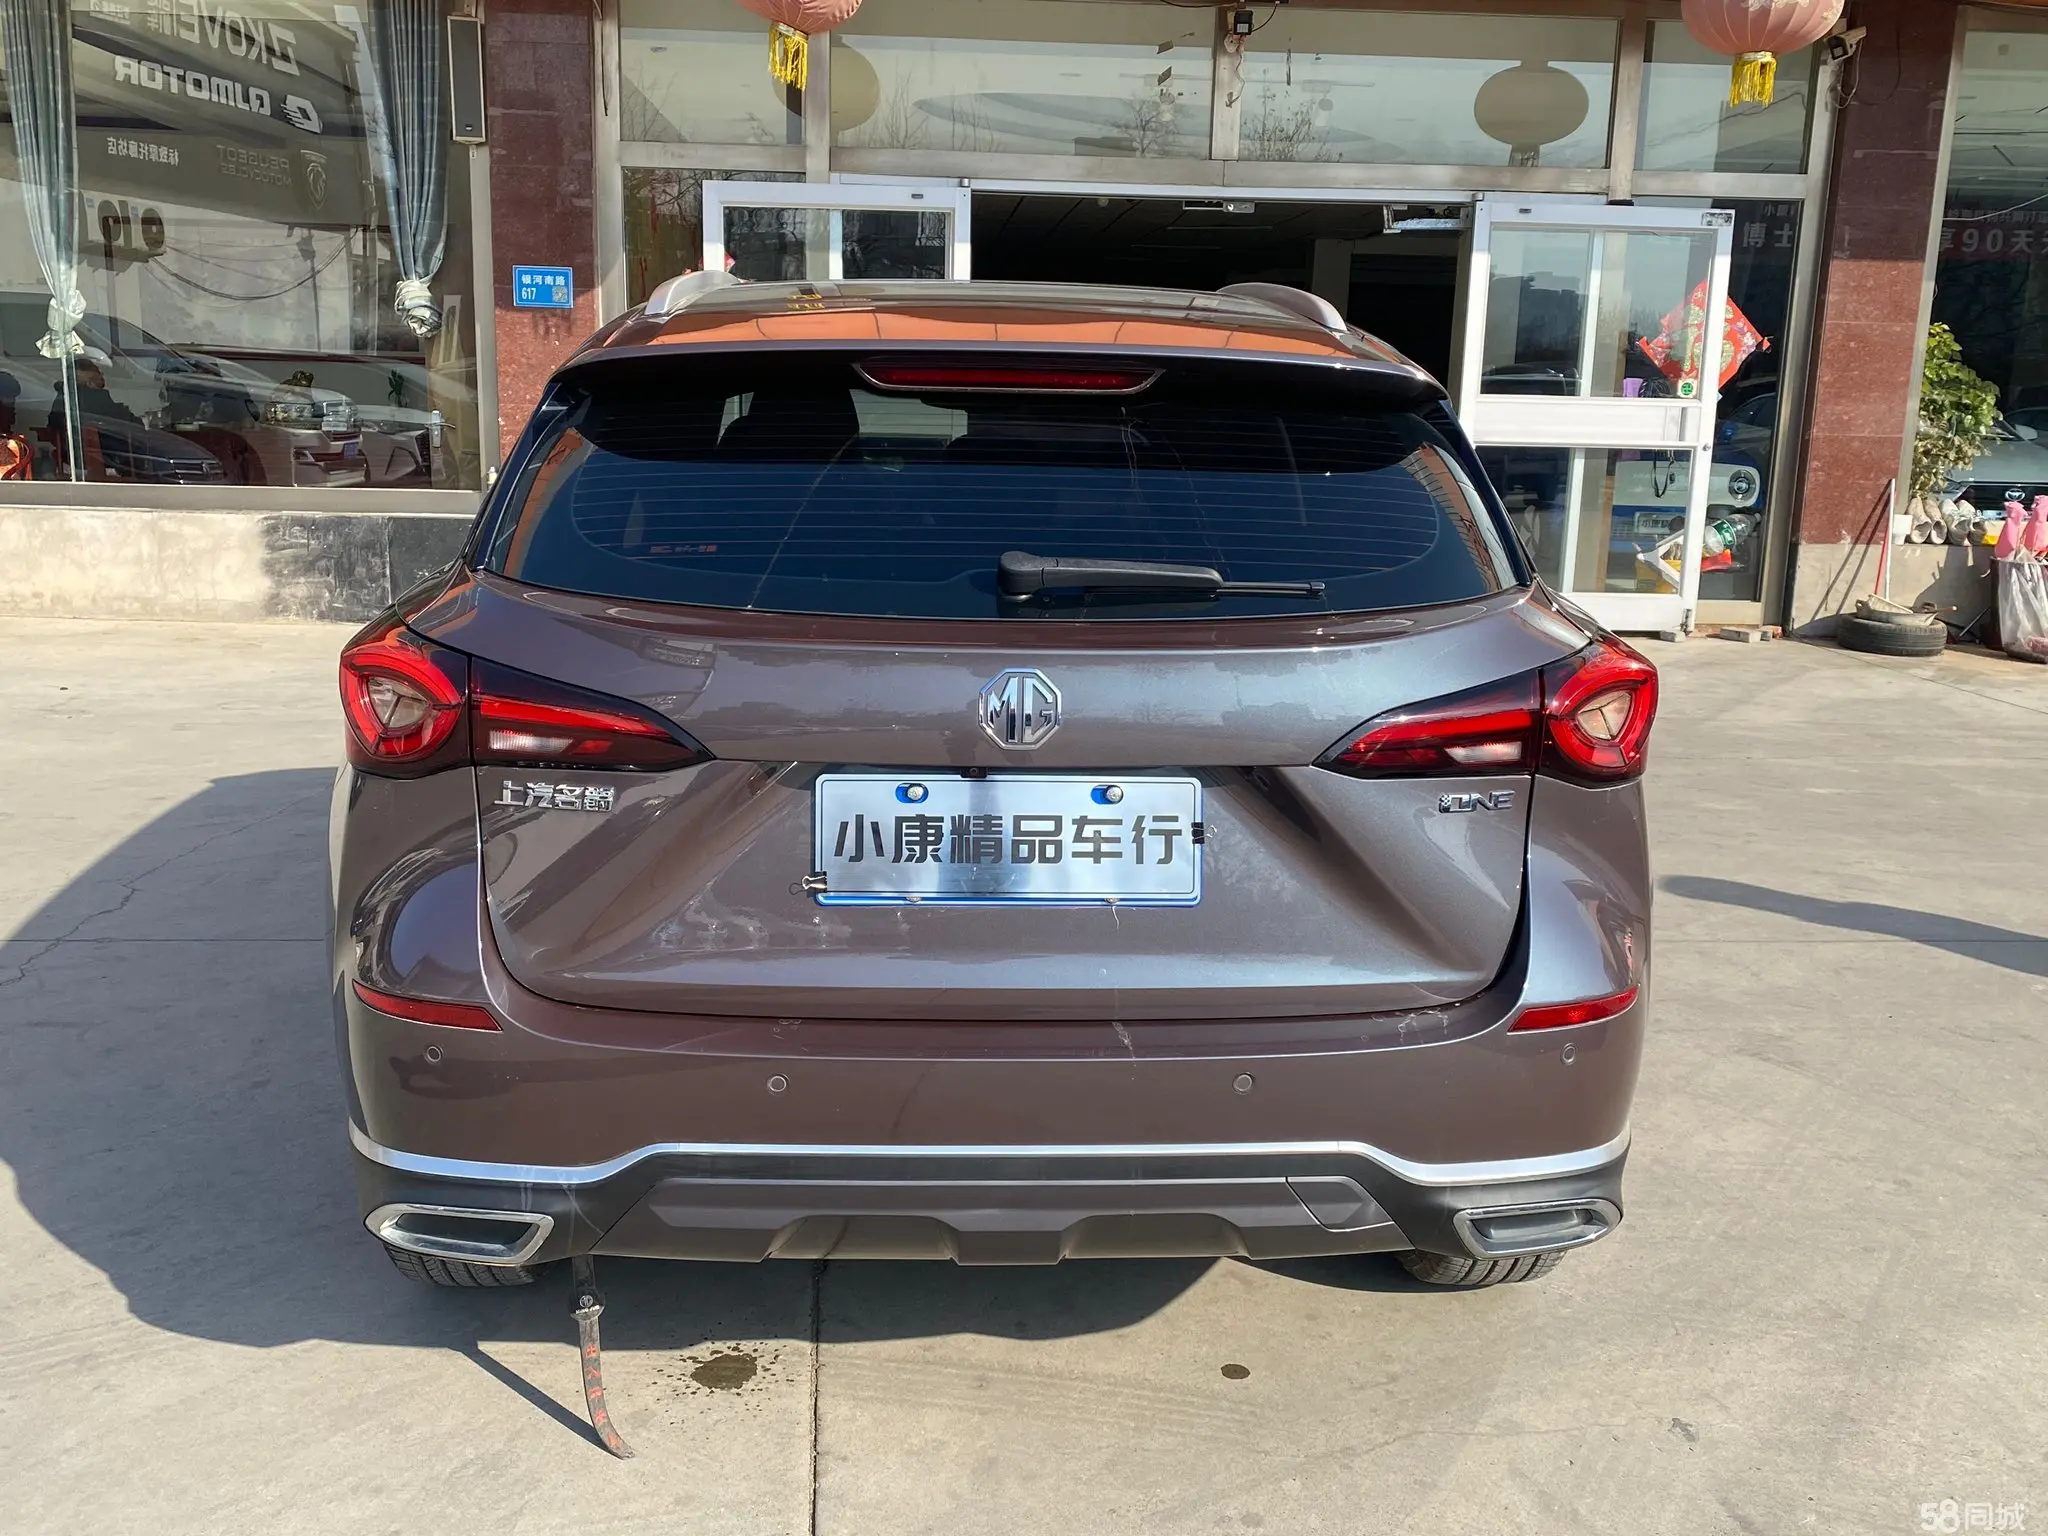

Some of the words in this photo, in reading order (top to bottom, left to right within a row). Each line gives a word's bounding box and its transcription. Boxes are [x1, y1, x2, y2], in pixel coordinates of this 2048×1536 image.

[521, 274, 566, 286] 银河南路
[521, 287, 536, 300] 617
[986, 676, 1054, 743] MG
[834, 814, 1183, 865] 小康精品车行
